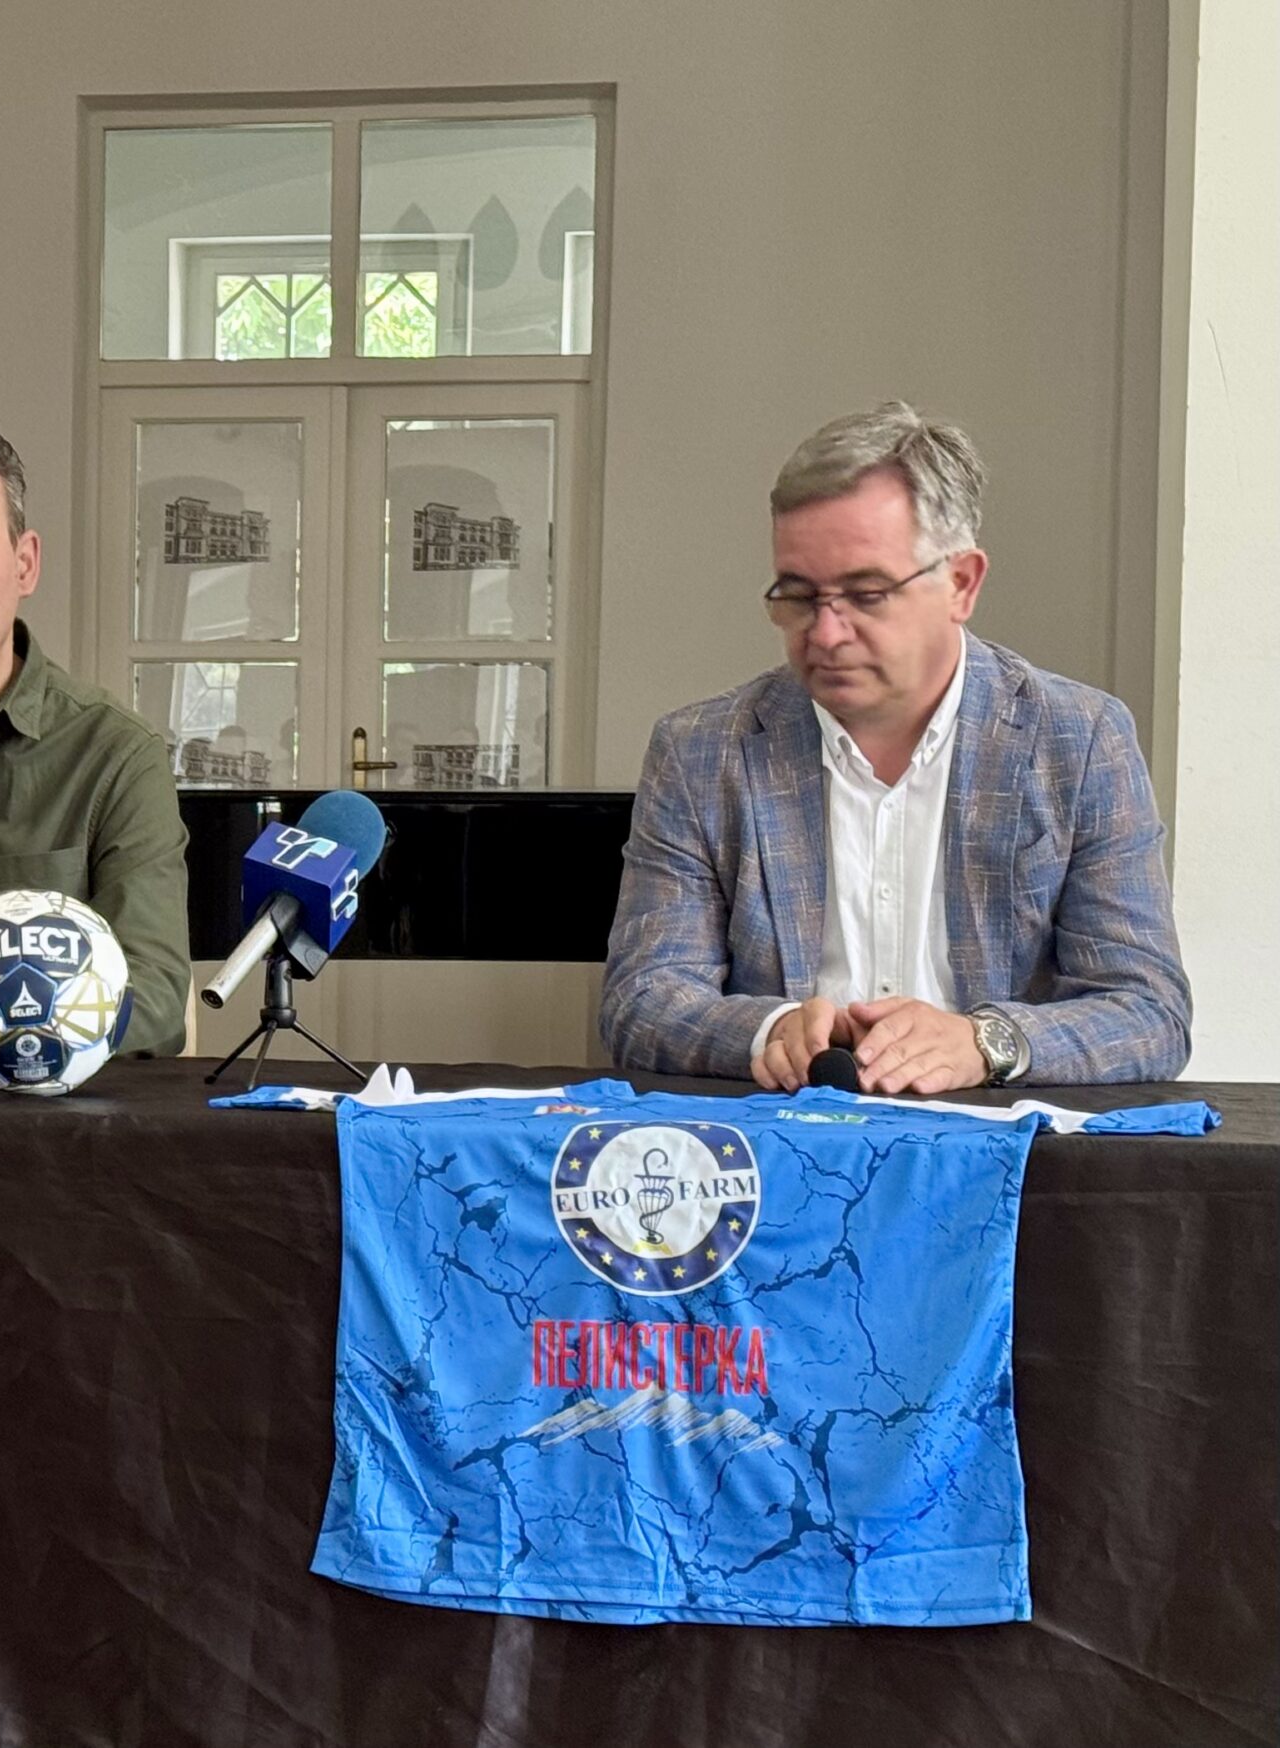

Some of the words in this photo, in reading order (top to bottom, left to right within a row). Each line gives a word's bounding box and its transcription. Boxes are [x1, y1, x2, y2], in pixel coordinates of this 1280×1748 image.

[10, 1005, 42, 1018] SELECT
[555, 1186, 631, 1214] EURO
[679, 1175, 758, 1202] FARM
[533, 1320, 769, 1396] ПЕЛИСТЕРКА
